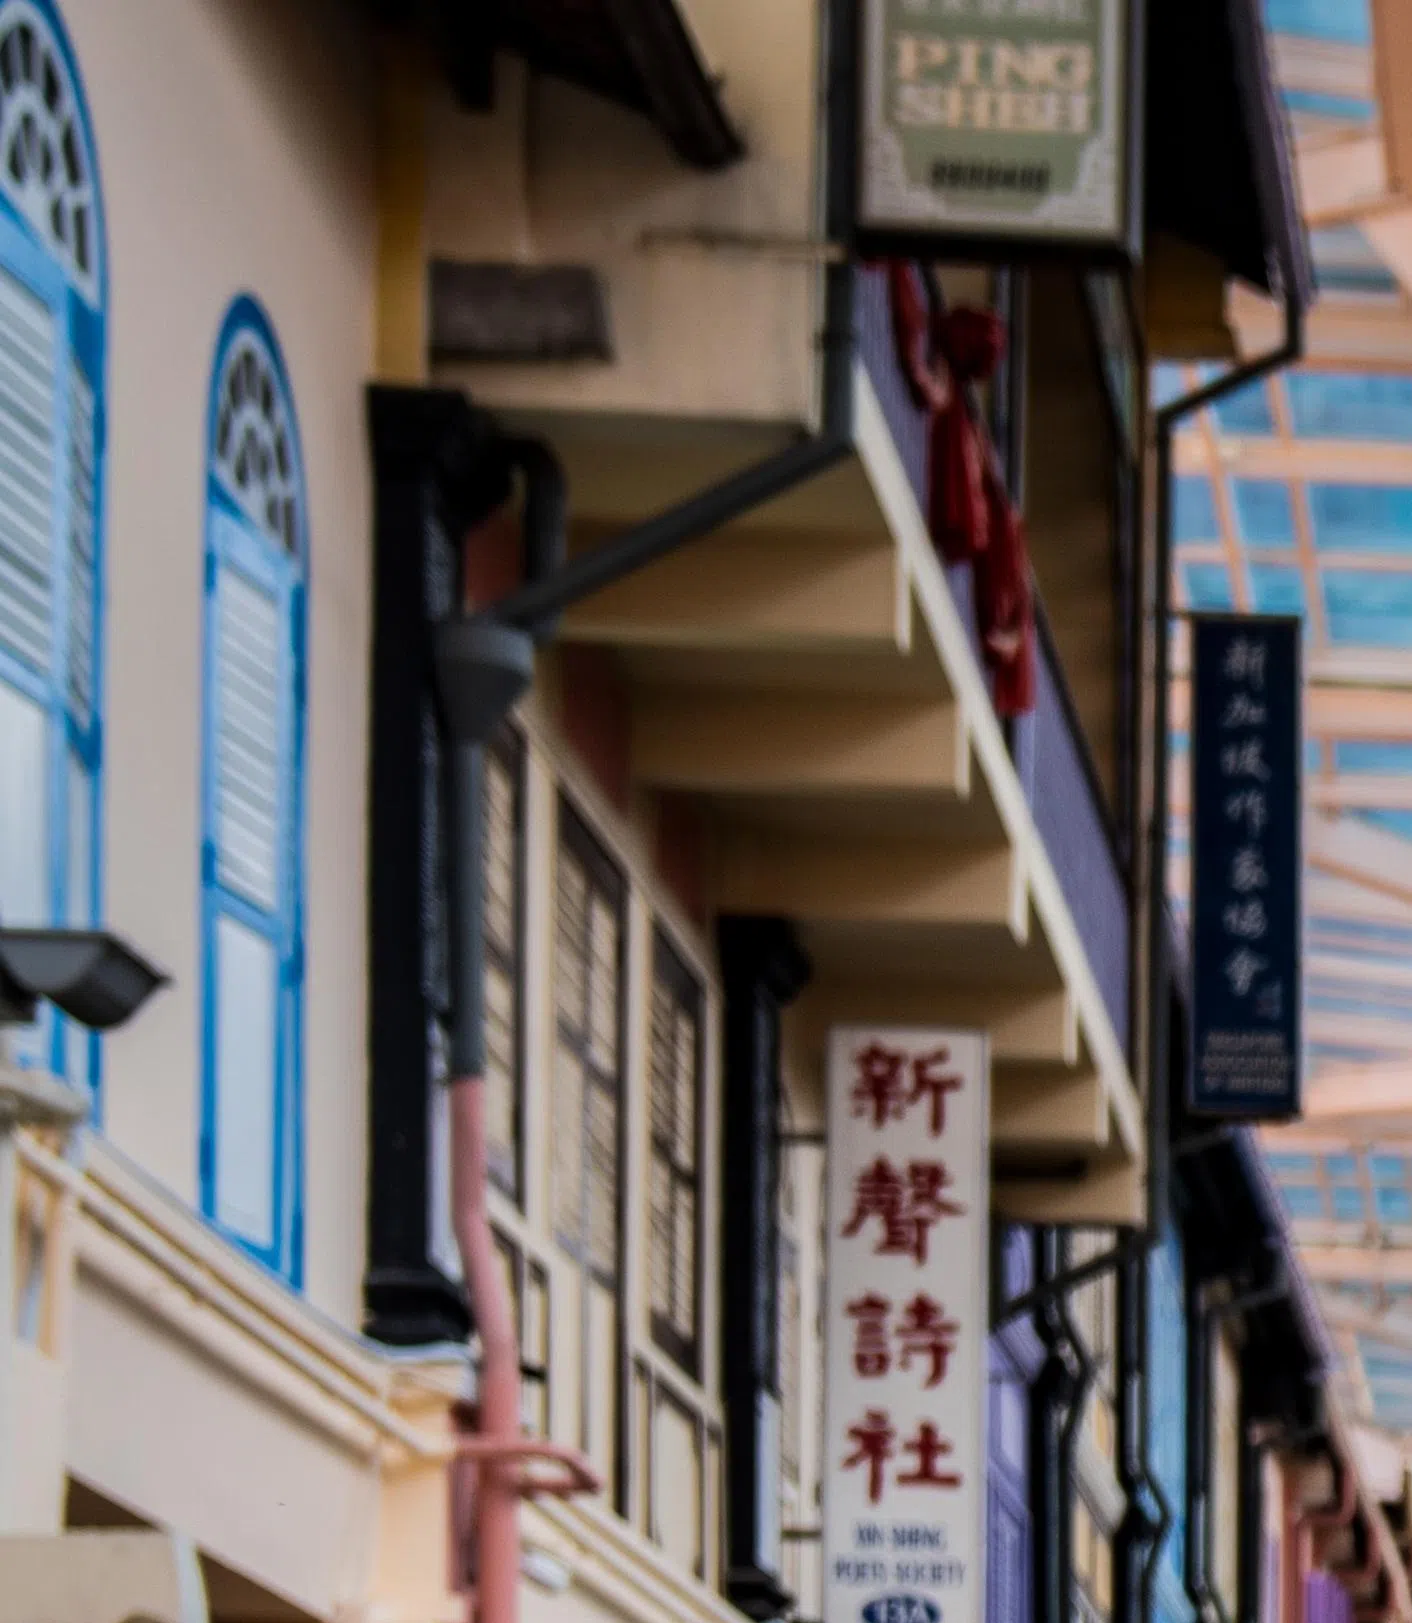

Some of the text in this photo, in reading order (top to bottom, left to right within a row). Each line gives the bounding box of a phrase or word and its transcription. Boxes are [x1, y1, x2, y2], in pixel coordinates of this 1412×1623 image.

[894, 32, 1094, 88] PING
[840, 1040, 965, 1506] 新聲詩社
